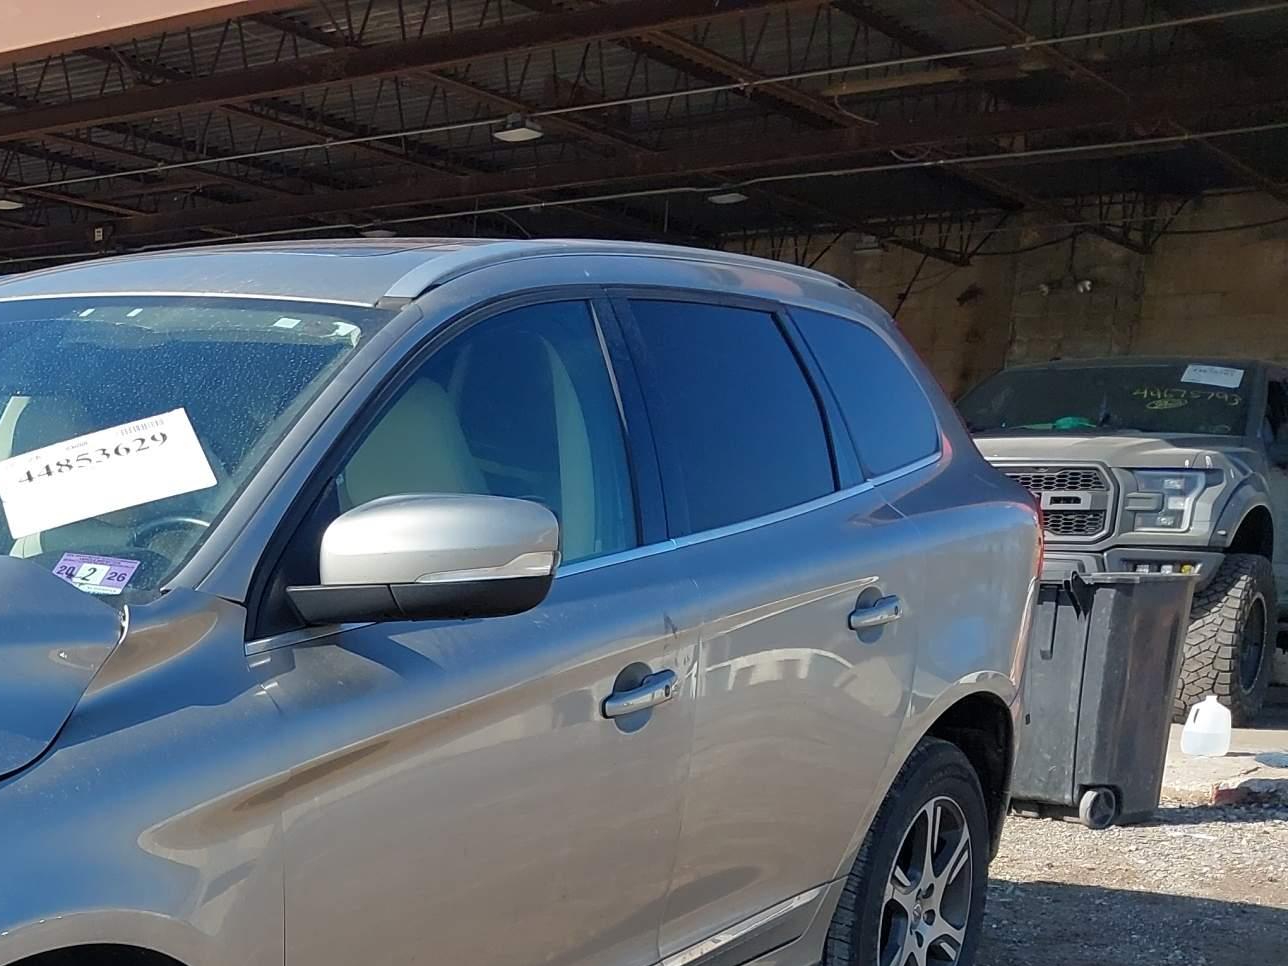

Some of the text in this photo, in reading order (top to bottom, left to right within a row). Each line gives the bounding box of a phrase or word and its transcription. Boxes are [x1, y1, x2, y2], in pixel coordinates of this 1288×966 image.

[18, 431, 168, 483] 44853629
[81, 567, 97, 581] 2
[107, 571, 127, 582] 26
